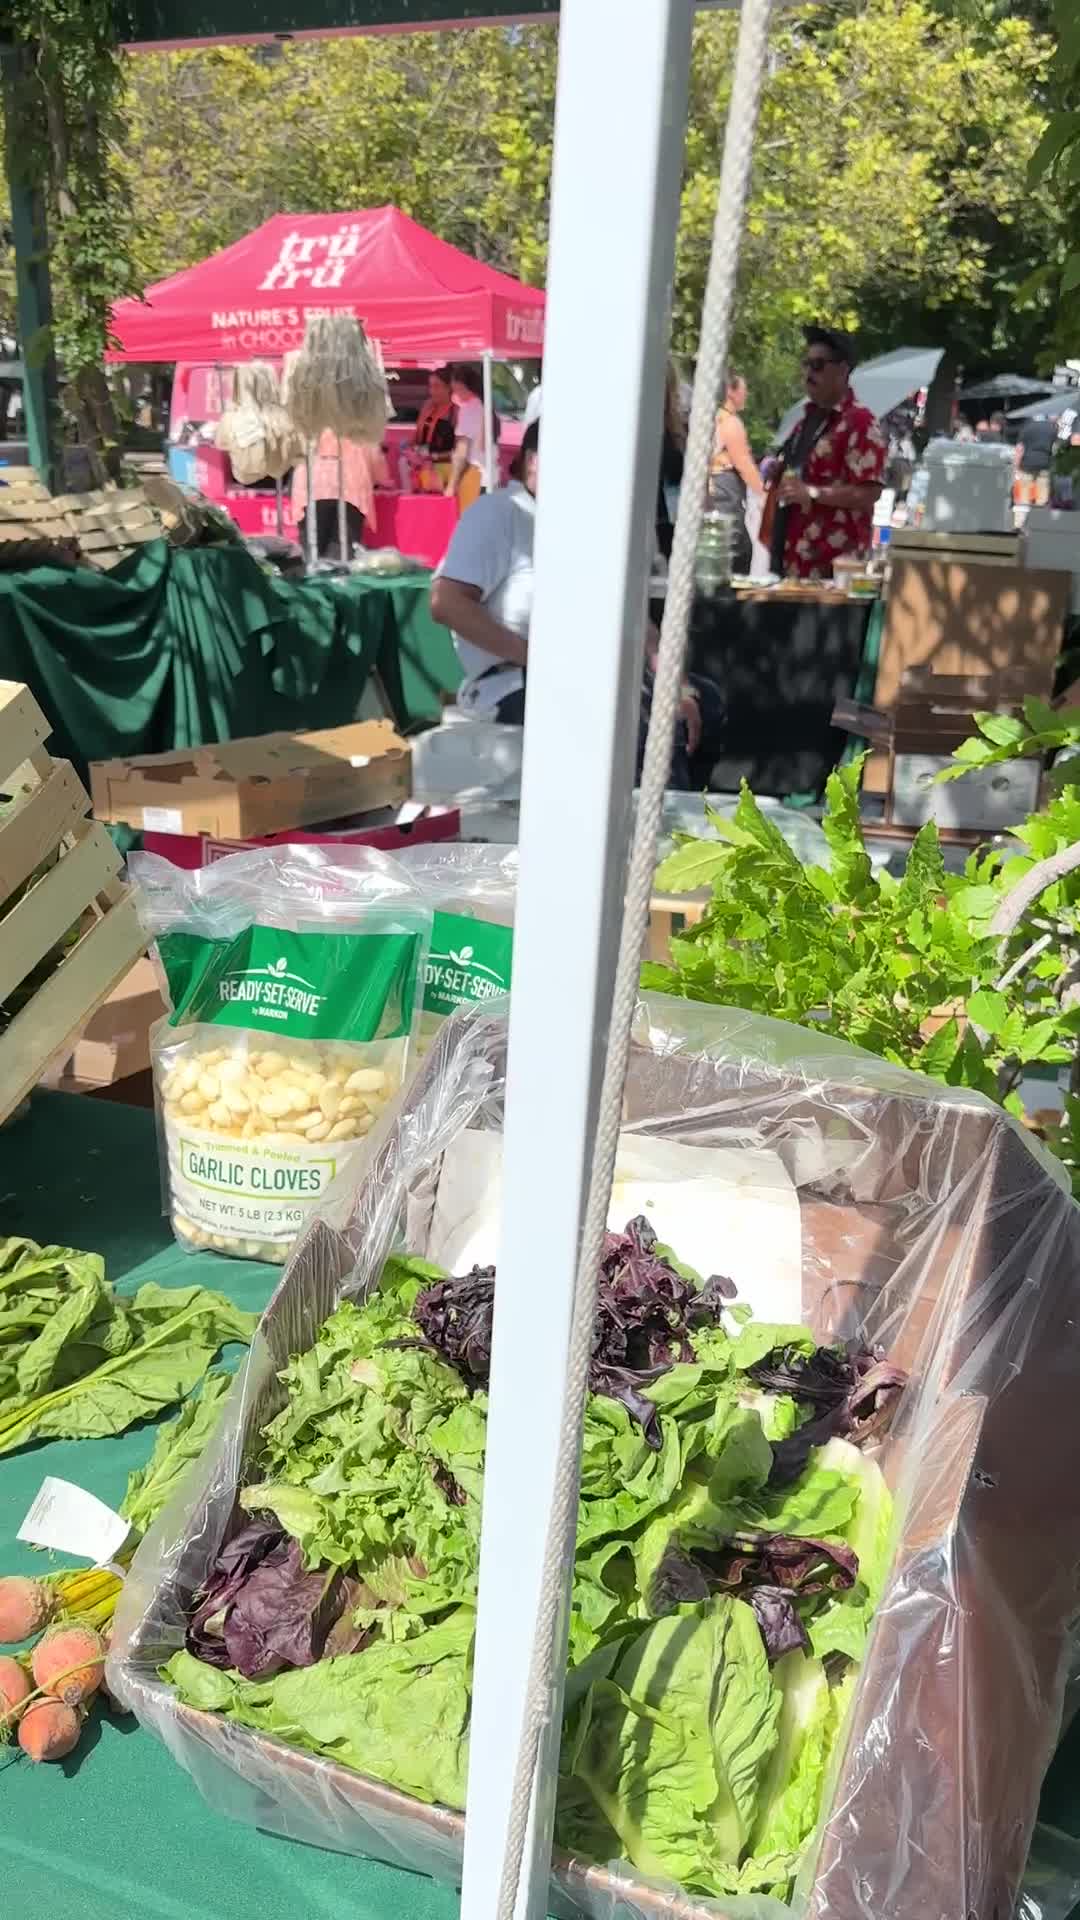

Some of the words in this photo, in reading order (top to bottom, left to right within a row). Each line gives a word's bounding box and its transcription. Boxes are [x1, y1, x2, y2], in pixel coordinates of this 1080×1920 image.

[279, 224, 360, 263] trü
[256, 257, 346, 290] frü
[211, 307, 300, 329] NATURE'S
[239, 329, 305, 350] CHOCO
[219, 980, 320, 1016] READY-SET-SERVE
[259, 1006, 289, 1020] MARKON
[188, 1152, 244, 1186] GARLIC
[251, 1167, 321, 1190] CLOVES
[199, 1198, 217, 1212] NET
[219, 1204, 236, 1218] WT.
[239, 1208, 245, 1218] 5
[247, 1210, 261, 1221] LB
[286, 1211, 305, 1222] KG)
